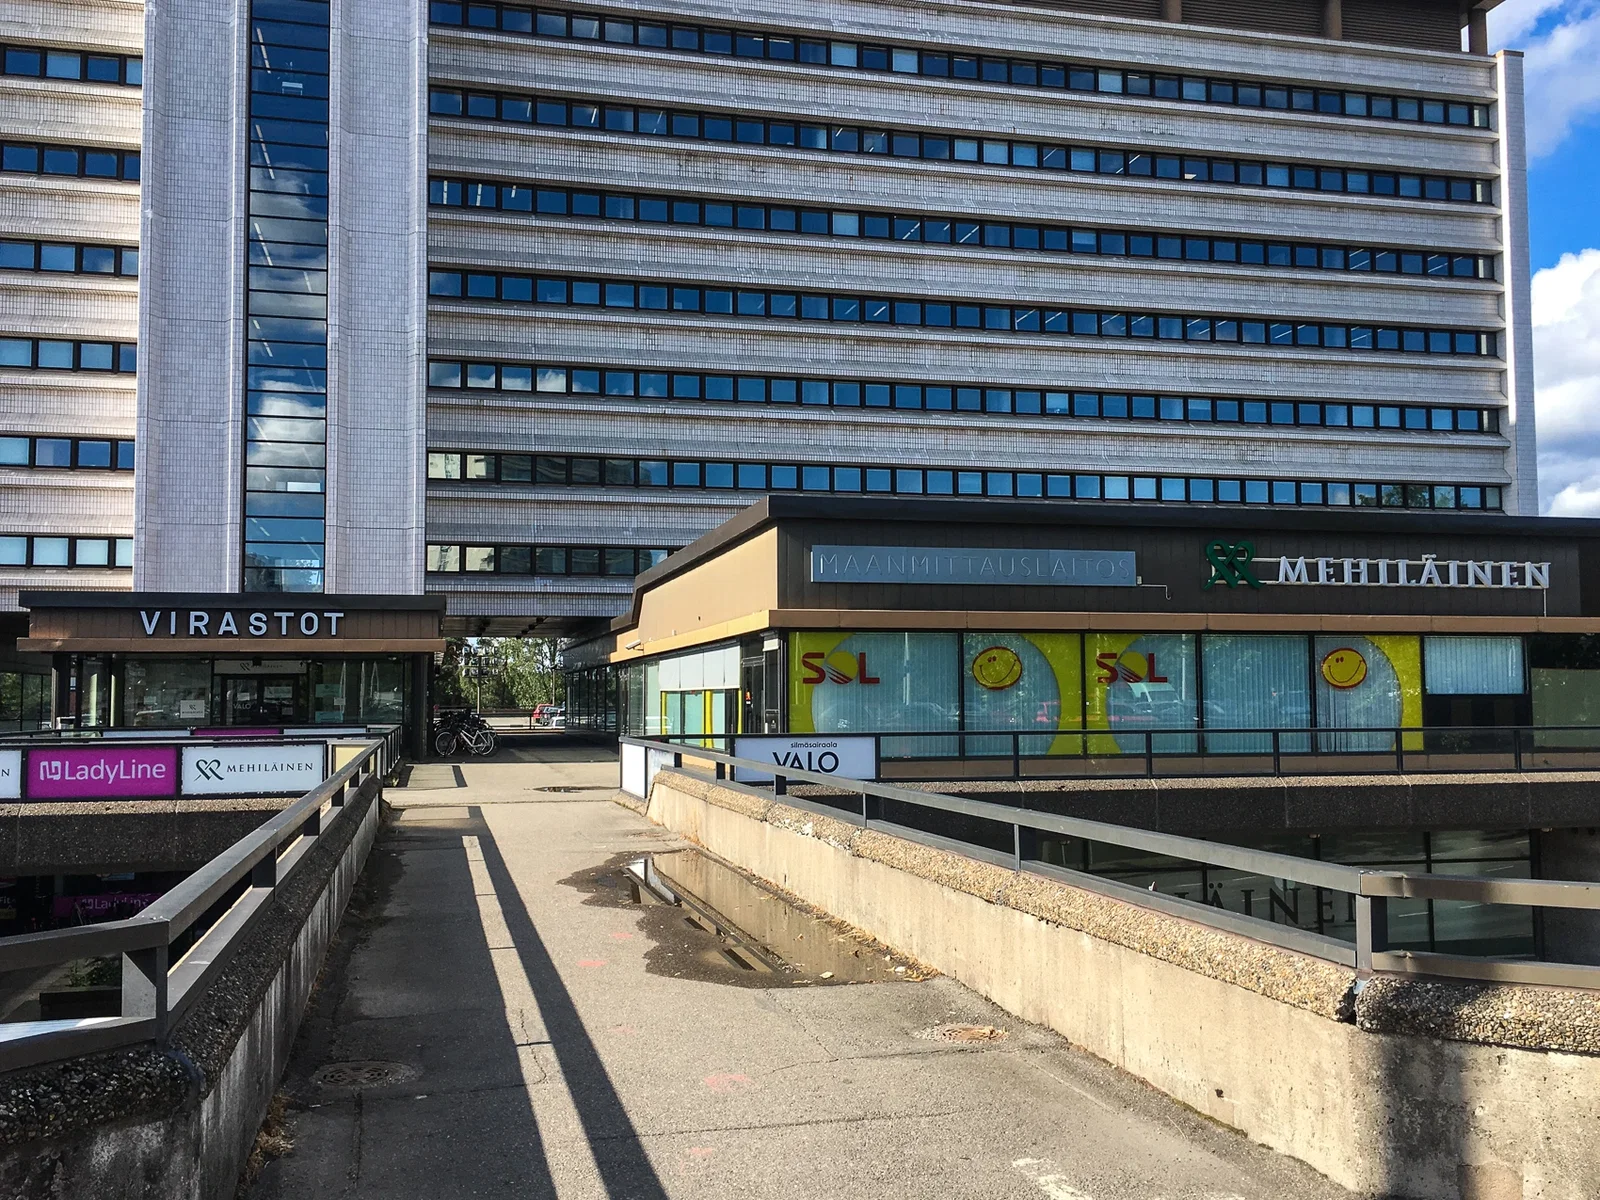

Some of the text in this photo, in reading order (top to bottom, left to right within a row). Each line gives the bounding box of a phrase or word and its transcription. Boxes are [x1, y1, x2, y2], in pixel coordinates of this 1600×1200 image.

[819, 553, 1130, 580] MAANMITTAUSLAITOS
[1277, 553, 1551, 589] MEHILÄINEN
[140, 611, 345, 636] VIRASTOT
[801, 650, 880, 684] SOL
[1096, 650, 1168, 683] SOL
[65, 759, 166, 784] LadyLine
[226, 761, 314, 773] MEHILÄINEN
[772, 751, 839, 774] VALO
[1173, 882, 1357, 925] ÄINE
